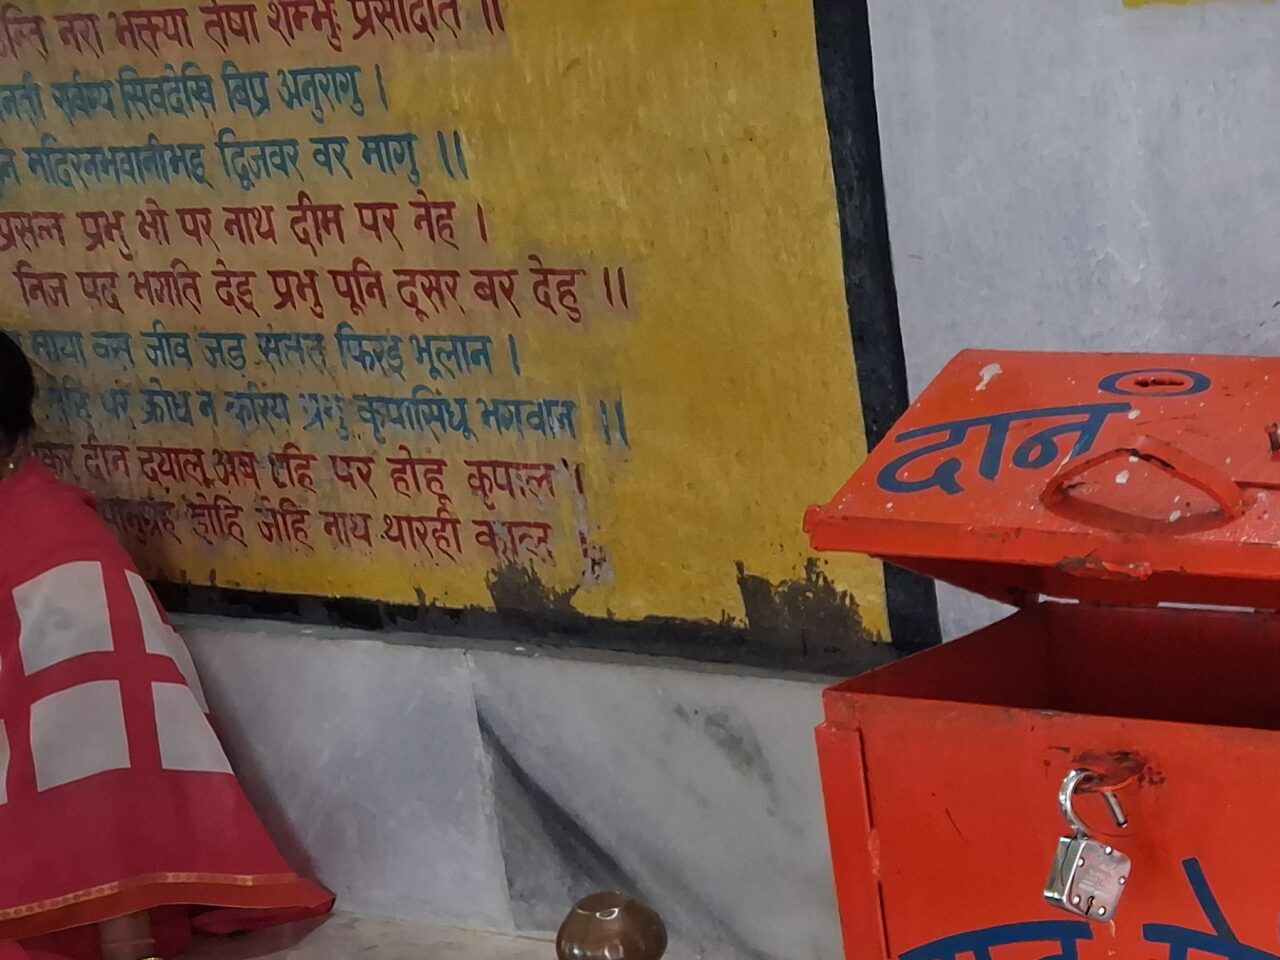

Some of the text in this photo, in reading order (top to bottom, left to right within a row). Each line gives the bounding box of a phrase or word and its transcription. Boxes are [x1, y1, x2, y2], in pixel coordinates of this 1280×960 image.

[76, 210, 133, 261] प्रभु
[176, 207, 220, 252] पर
[223, 205, 277, 246] नाथ
[354, 202, 404, 252] पर
[12, 260, 69, 307] निज
[76, 271, 125, 314] पद
[128, 258, 202, 315] भगति
[267, 269, 324, 319] प्रभु
[140, 319, 193, 367] जीव
[329, 454, 377, 498] पर
[875, 403, 1131, 495] दान
